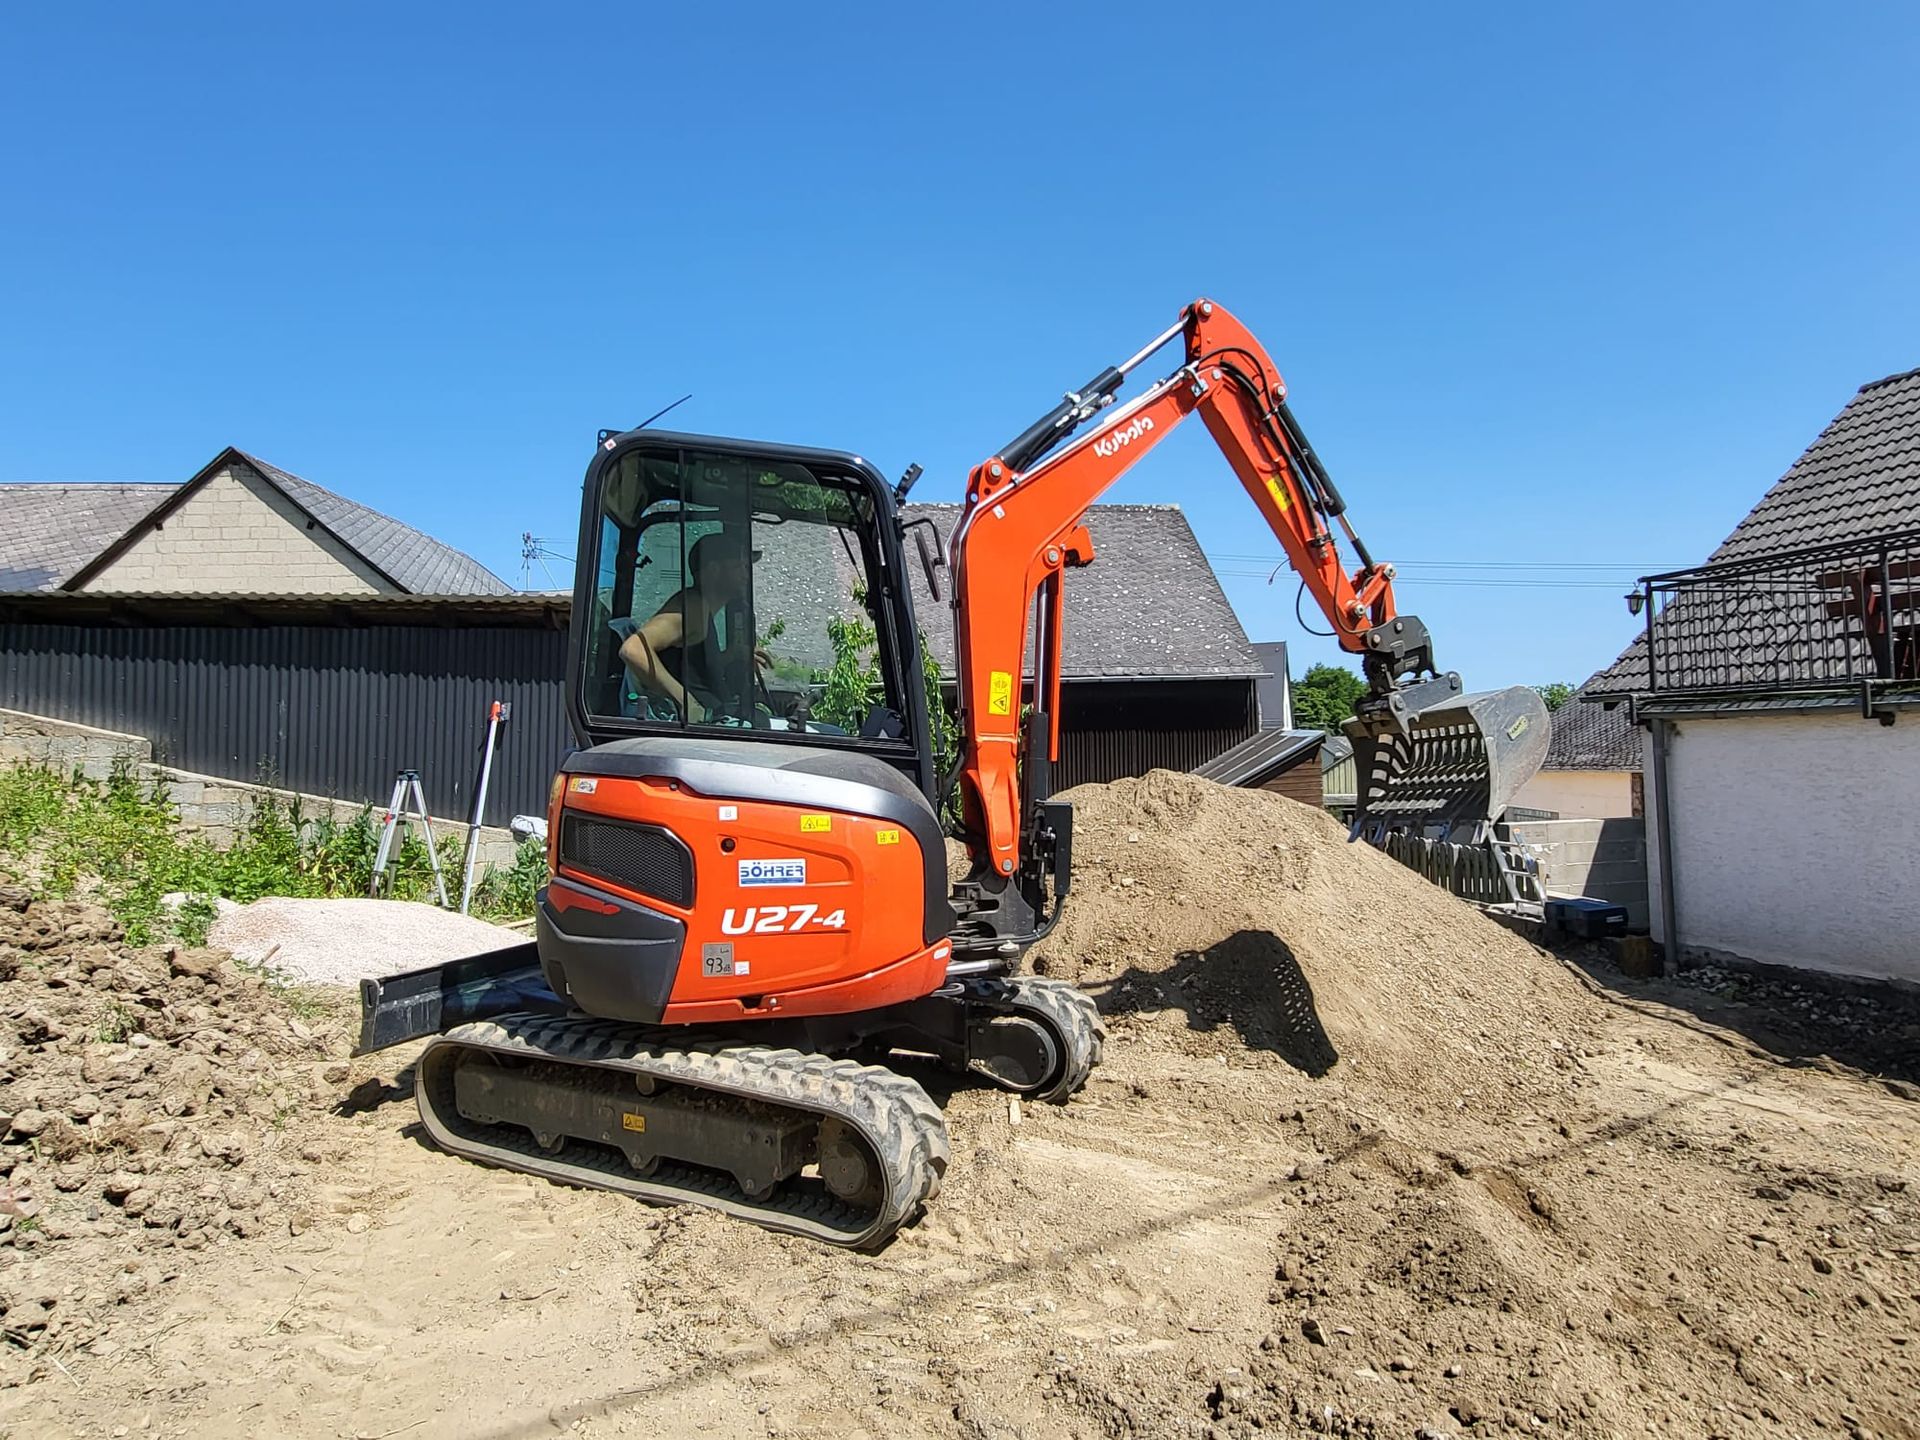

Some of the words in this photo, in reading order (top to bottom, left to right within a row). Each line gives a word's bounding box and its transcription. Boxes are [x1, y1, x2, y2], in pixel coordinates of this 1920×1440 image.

[1093, 416, 1155, 458] Kubota
[740, 861, 804, 877] SÖHRER
[721, 903, 846, 935] U27-4
